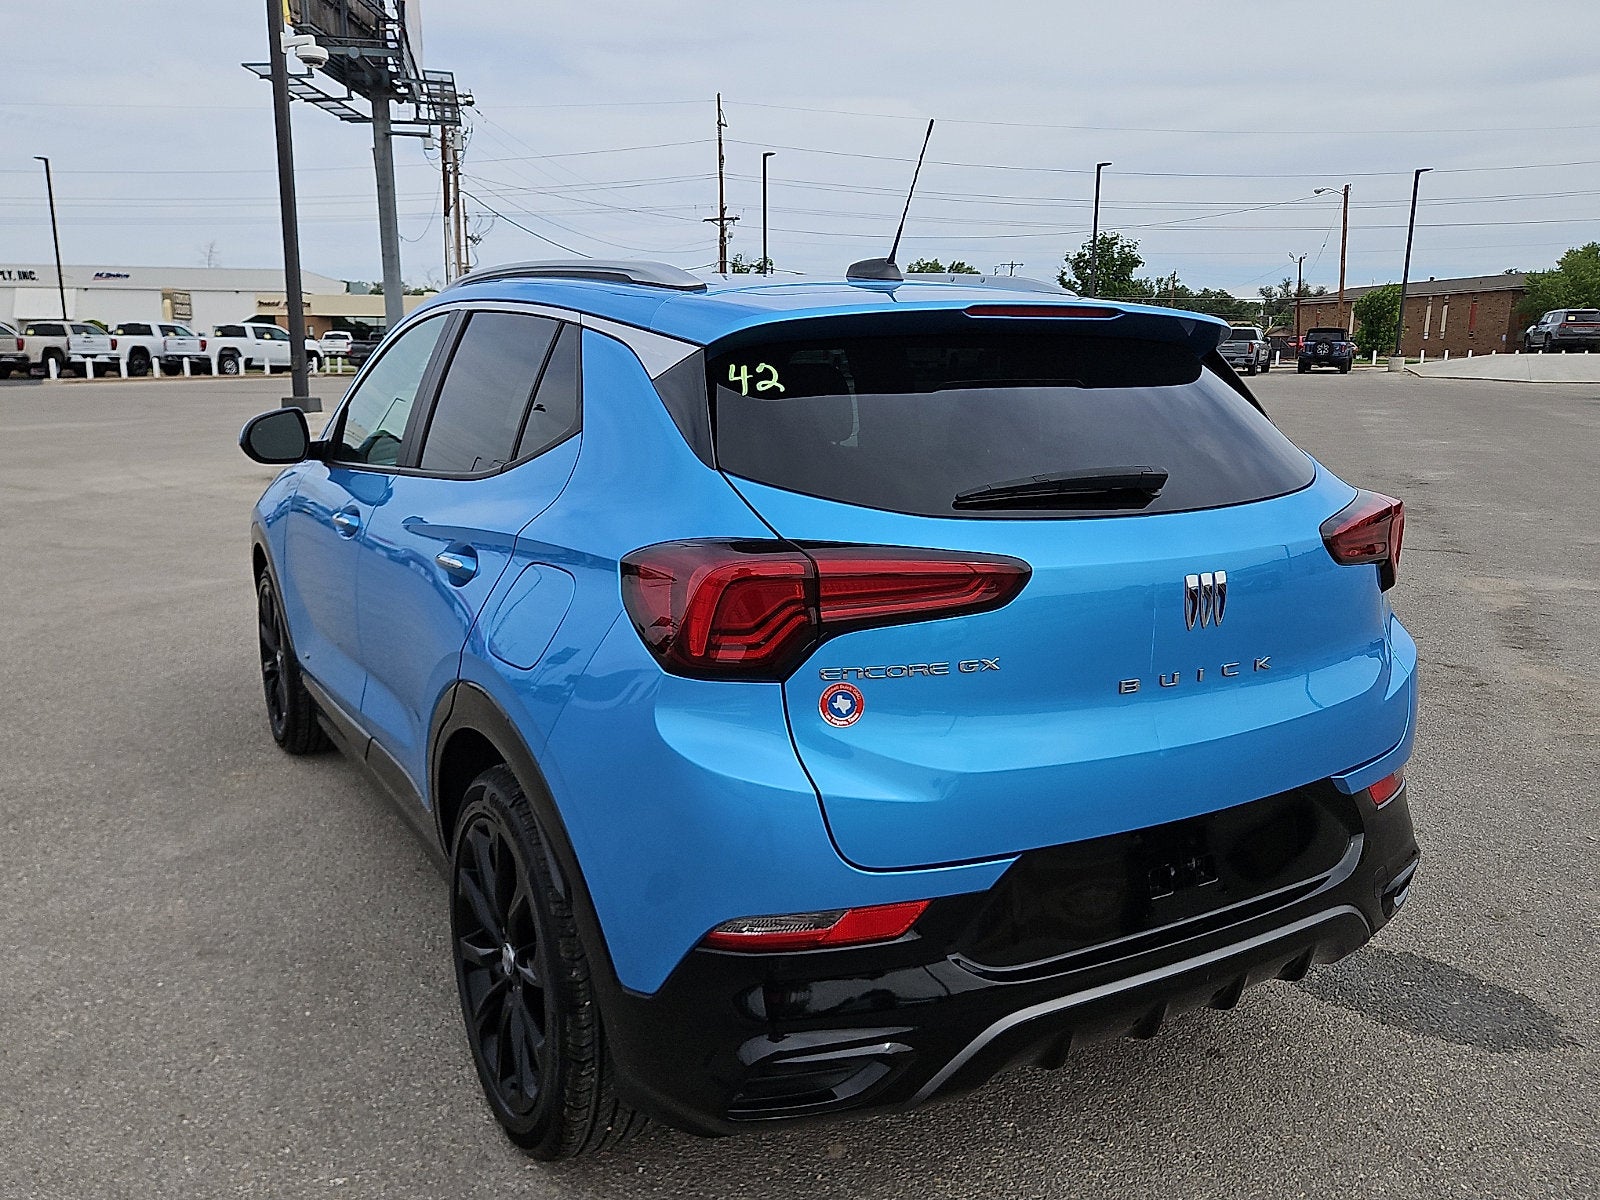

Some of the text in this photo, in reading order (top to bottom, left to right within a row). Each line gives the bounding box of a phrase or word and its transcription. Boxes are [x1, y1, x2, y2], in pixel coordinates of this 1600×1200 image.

[18, 270, 39, 281] INC.
[728, 363, 785, 396] 42
[819, 657, 1001, 681] ENCORE GX
[1118, 655, 1272, 695] BUICK
